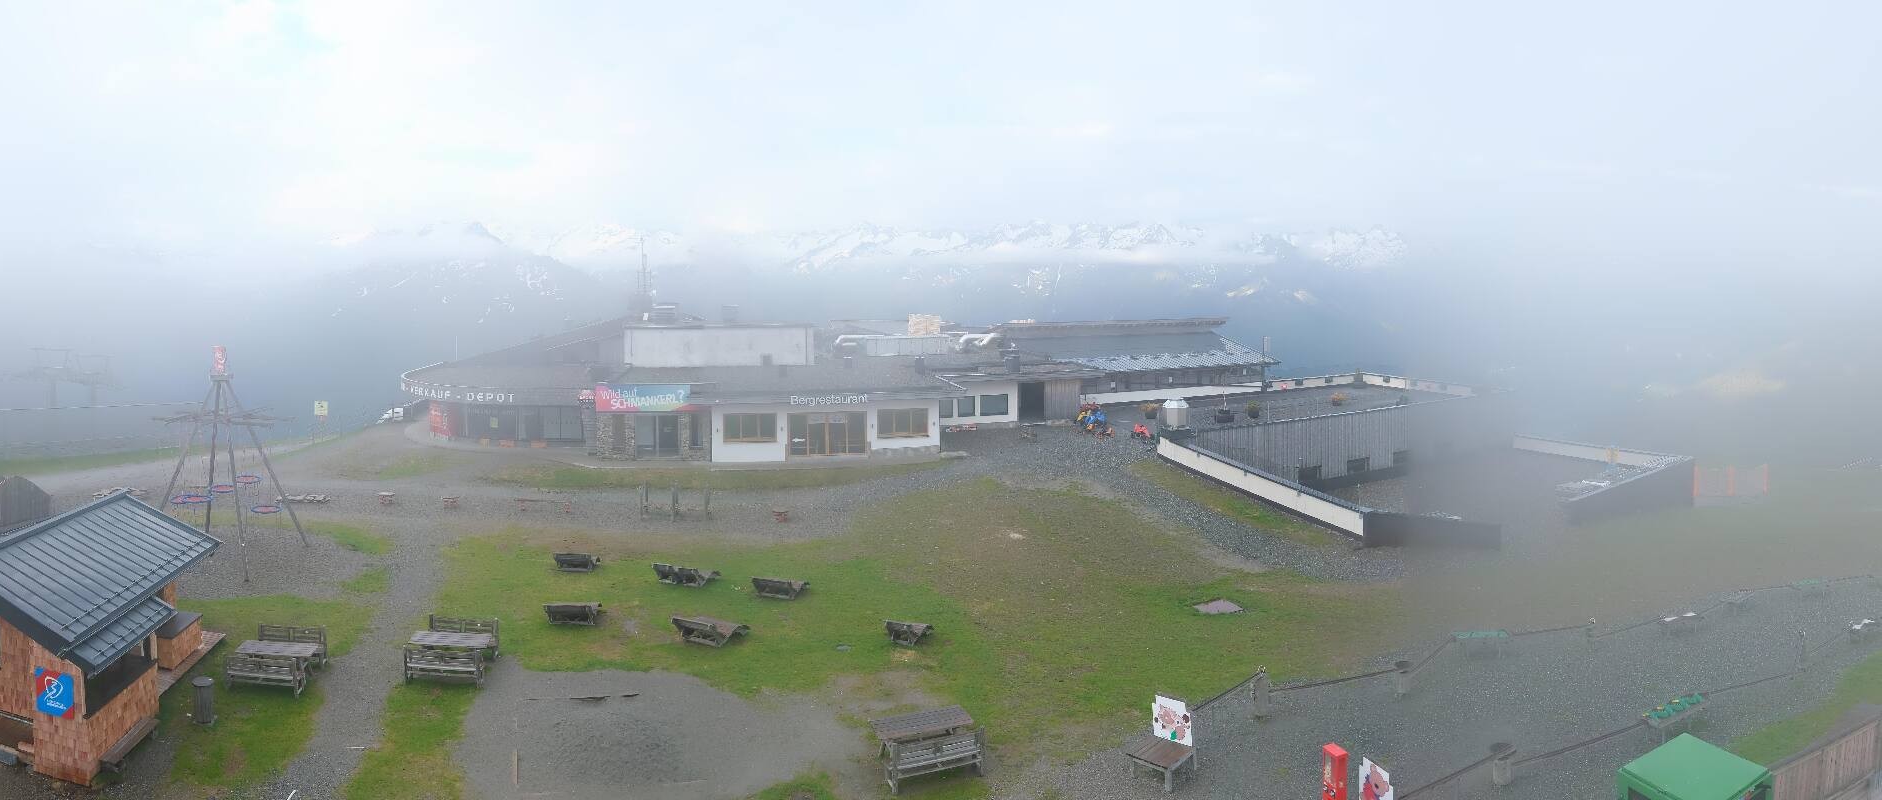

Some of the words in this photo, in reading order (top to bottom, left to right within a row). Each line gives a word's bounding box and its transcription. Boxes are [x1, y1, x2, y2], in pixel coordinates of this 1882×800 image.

[410, 386, 451, 399] VERKAUF
[467, 392, 515, 402] DEPOT
[601, 389, 621, 399] Wild
[622, 386, 637, 398] auf
[610, 389, 685, 409] SCHMANKERL?
[790, 393, 869, 406] Bergrestaurant
